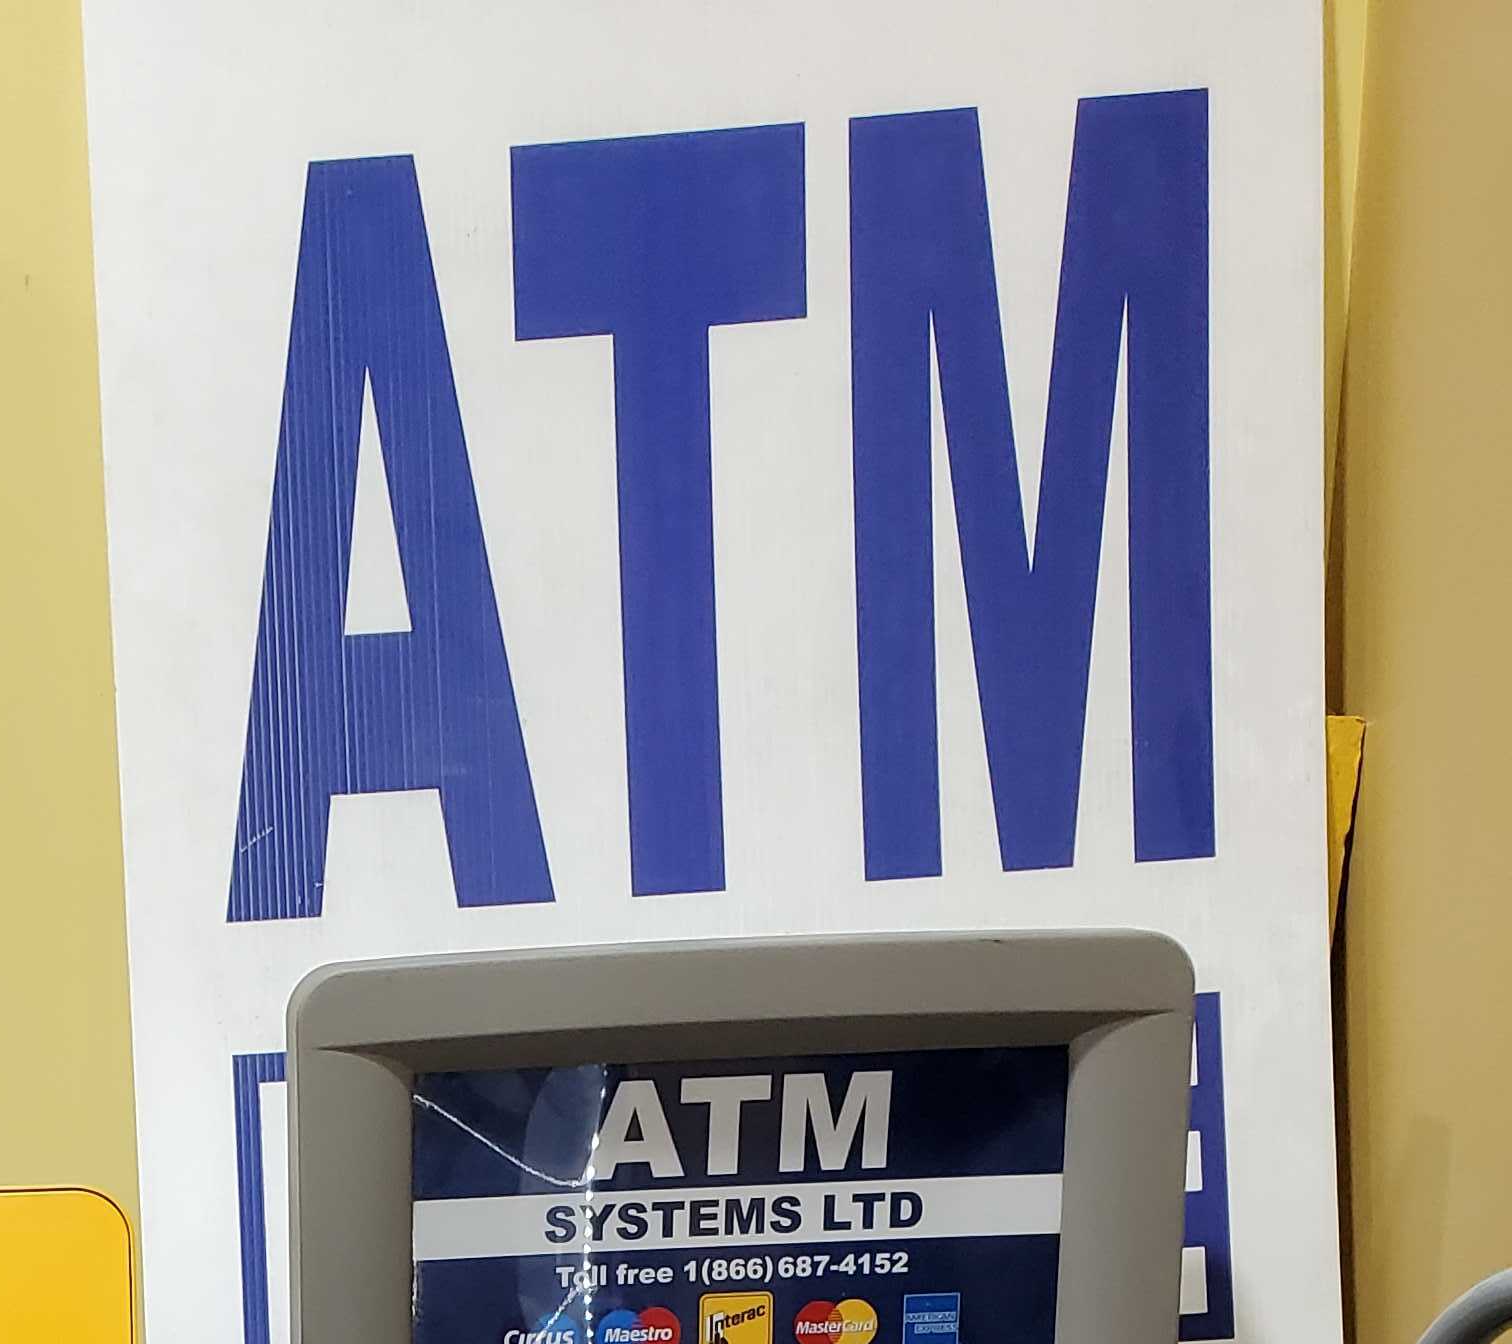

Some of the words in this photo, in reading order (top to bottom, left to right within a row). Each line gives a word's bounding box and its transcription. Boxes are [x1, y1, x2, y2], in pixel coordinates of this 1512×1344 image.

[226, 87, 1216, 923] ATM
[593, 1071, 893, 1181] ATM
[545, 1194, 802, 1245] SYSTEMS
[824, 1191, 923, 1231] LTD
[556, 1265, 606, 1288] Toll
[615, 1262, 673, 1285] free
[604, 1322, 672, 1344] Maestro
[706, 1303, 767, 1338] Interac
[795, 1316, 876, 1335] MasterCard
